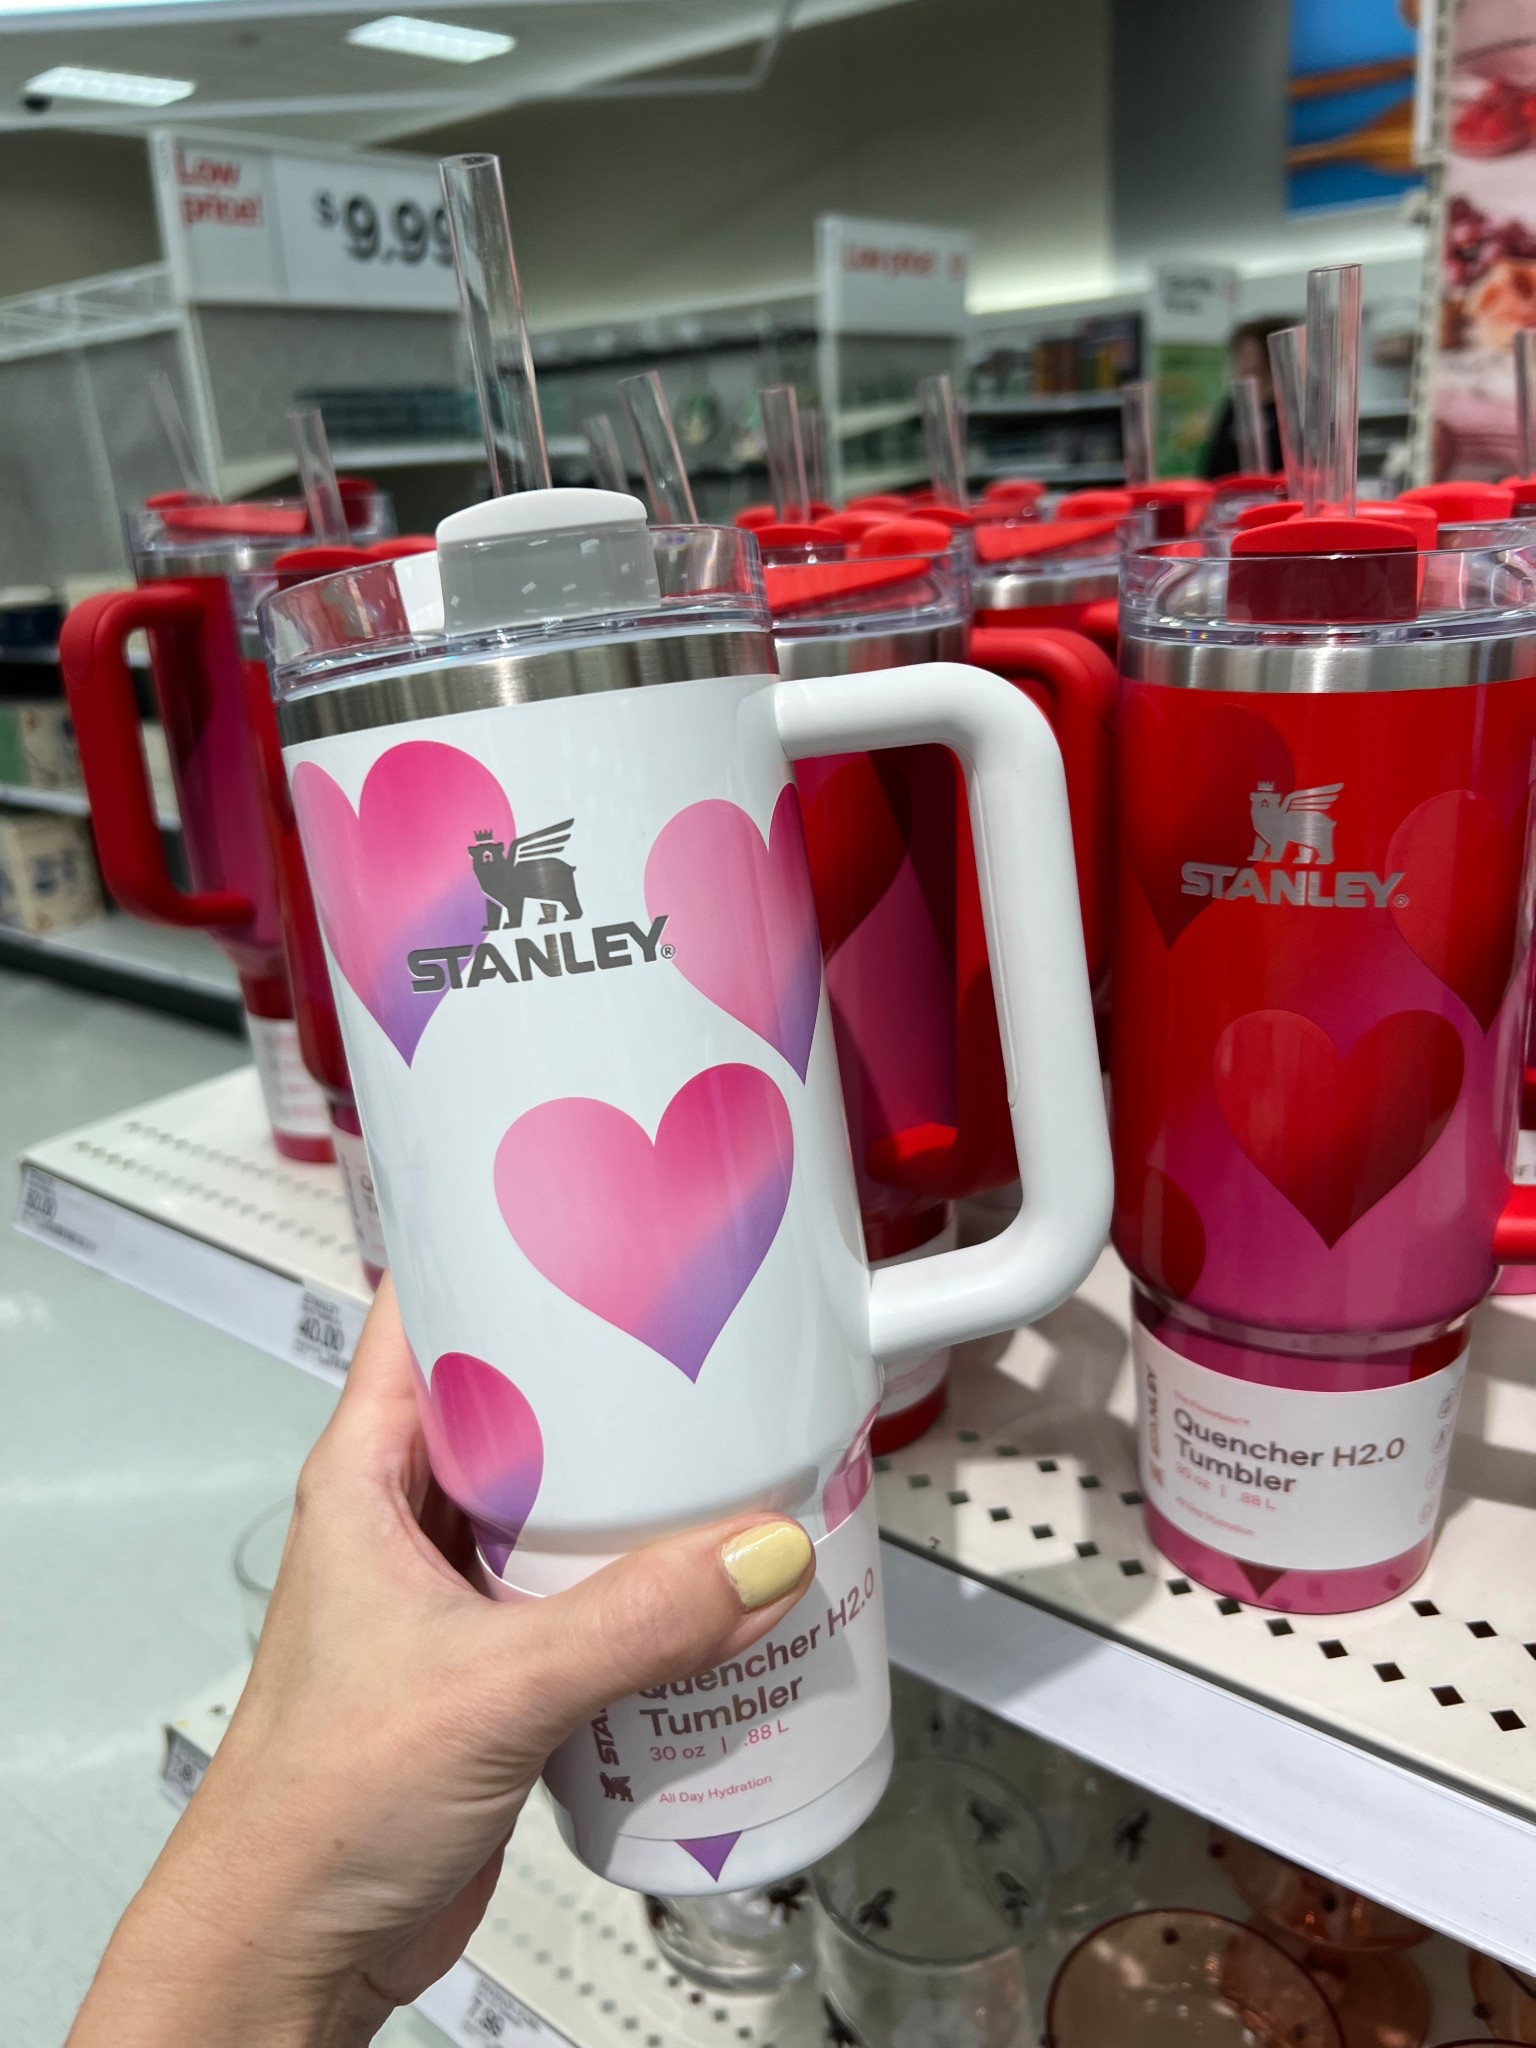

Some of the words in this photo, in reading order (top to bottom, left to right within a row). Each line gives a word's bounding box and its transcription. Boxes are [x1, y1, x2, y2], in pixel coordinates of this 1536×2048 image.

[1174, 1408, 1324, 1467] Quencher
[1332, 1437, 1405, 1468] H2.0
[1174, 1434, 1297, 1493] Tumbler
[827, 1567, 874, 1638] H2.0
[640, 1676, 803, 1737] Tumbler
[650, 1745, 677, 1762] 30
[683, 1745, 705, 1760] oz
[744, 1723, 773, 1747] .88
[777, 1718, 790, 1735] L
[659, 1792, 676, 1803] All
[679, 1791, 704, 1803] Day
[708, 1775, 772, 1800] Hydration
